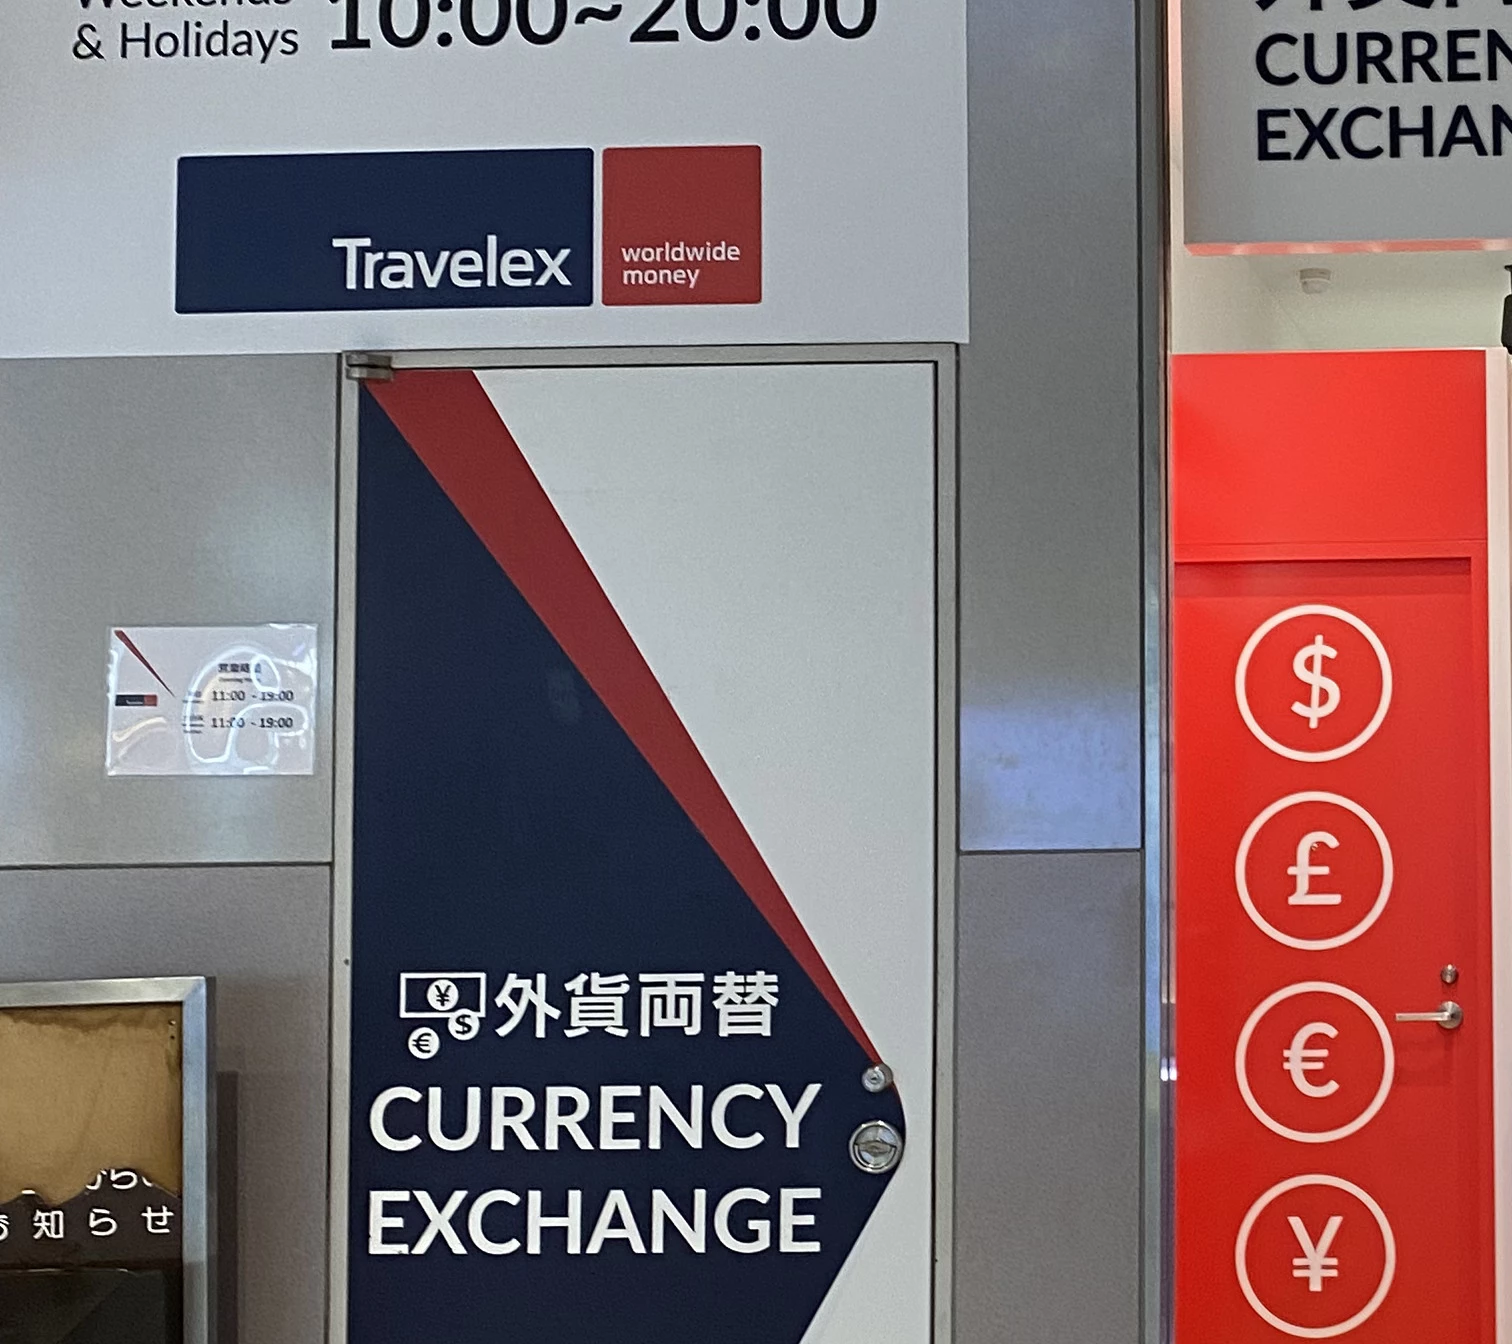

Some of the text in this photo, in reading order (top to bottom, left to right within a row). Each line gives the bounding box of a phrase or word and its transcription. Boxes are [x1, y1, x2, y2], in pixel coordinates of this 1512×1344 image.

[72, 19, 299, 65] & Holidays
[331, 234, 573, 290] Travelex
[621, 240, 741, 263] worldwide
[622, 266, 700, 289] money
[1290, 634, 1341, 729] $
[1287, 831, 1342, 906] £
[494, 970, 780, 1039] 外貨両替
[1283, 1021, 1339, 1098] €
[369, 1083, 823, 1152] CURRENCY
[368, 1187, 822, 1255] EXCHANGE
[1287, 1215, 1343, 1292] ¥
